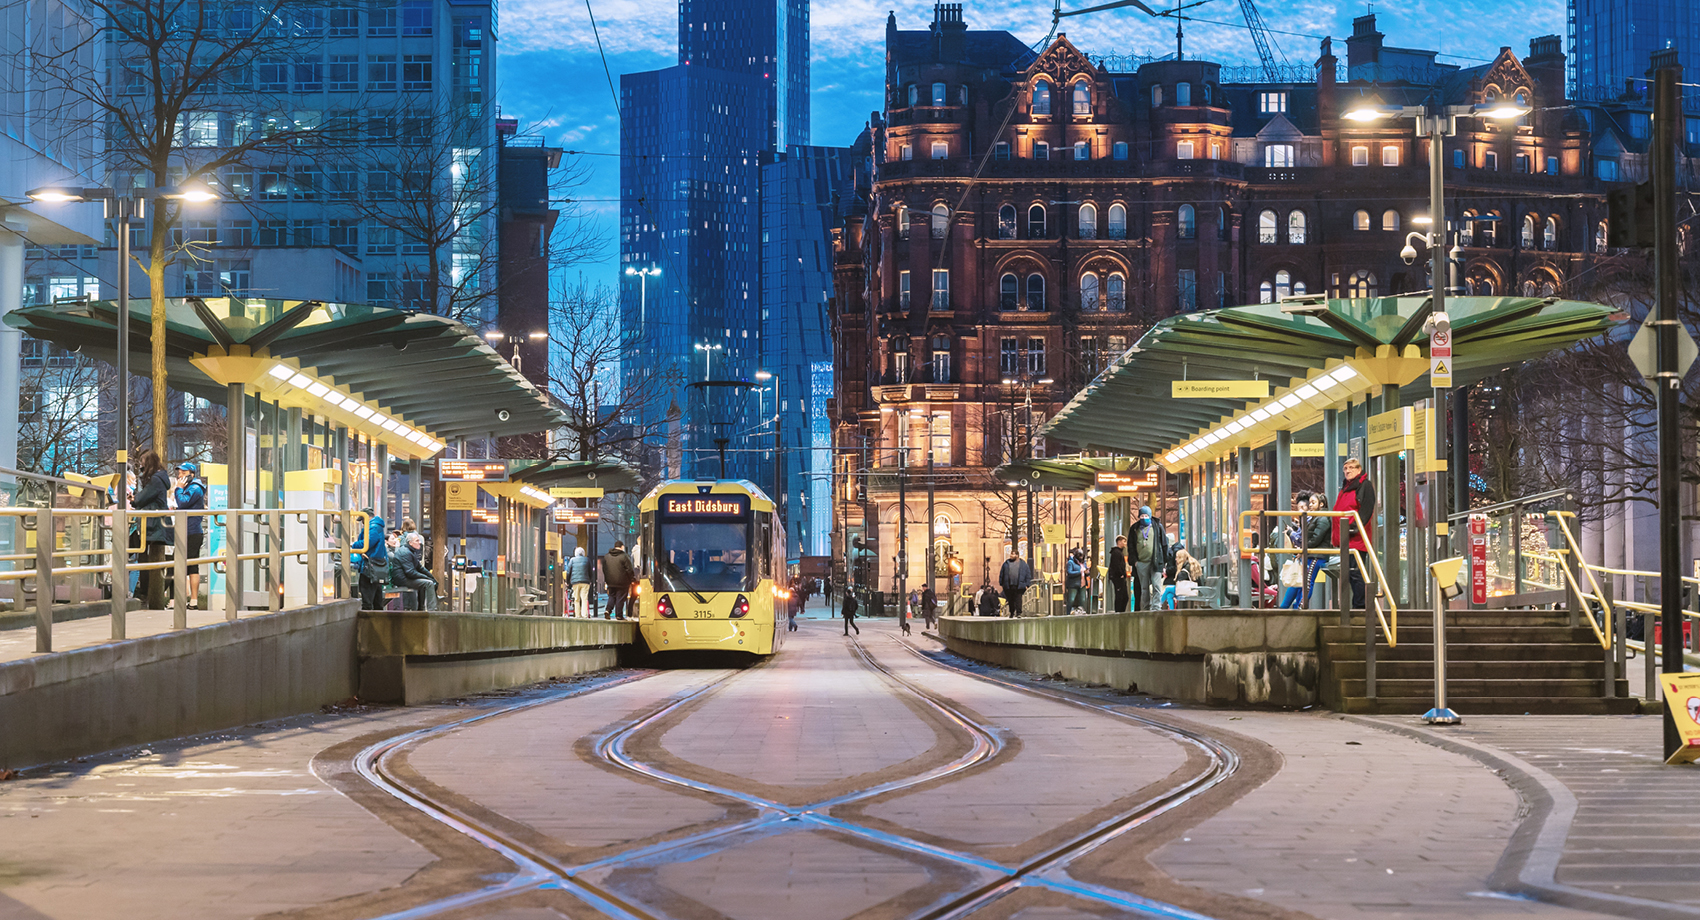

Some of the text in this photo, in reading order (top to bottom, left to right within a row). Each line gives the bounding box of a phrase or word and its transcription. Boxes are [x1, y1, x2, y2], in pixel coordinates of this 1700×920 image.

[668, 500, 740, 514] East Didsbury
[694, 610, 712, 618] 3115
